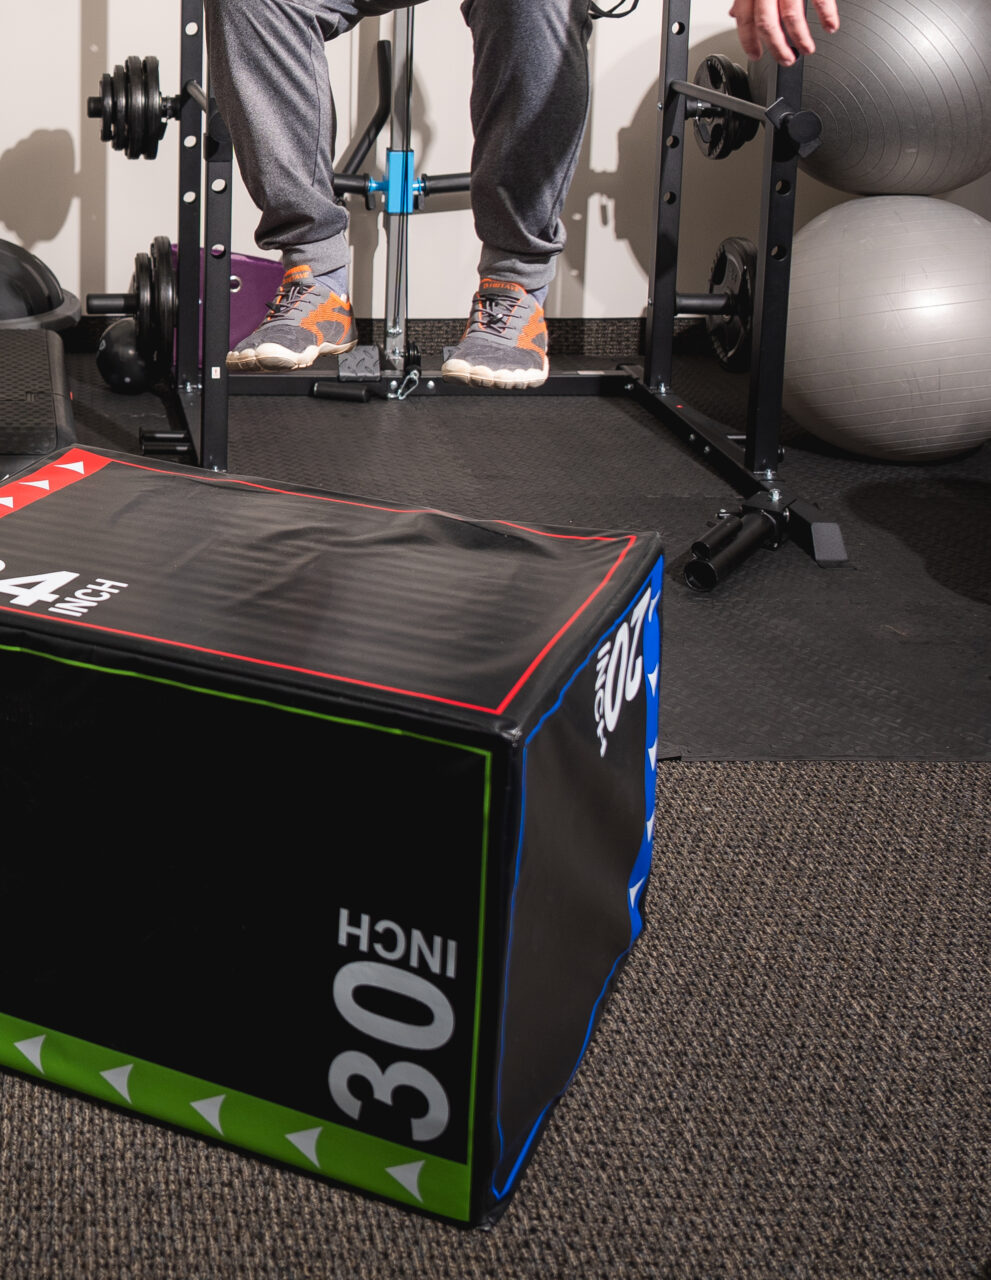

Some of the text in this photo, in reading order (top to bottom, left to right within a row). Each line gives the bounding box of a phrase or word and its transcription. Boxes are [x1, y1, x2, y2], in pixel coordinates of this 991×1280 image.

[48, 578, 129, 617] INCH
[604, 586, 652, 732] 20
[337, 907, 458, 979] INCH
[328, 960, 456, 1141] 30
